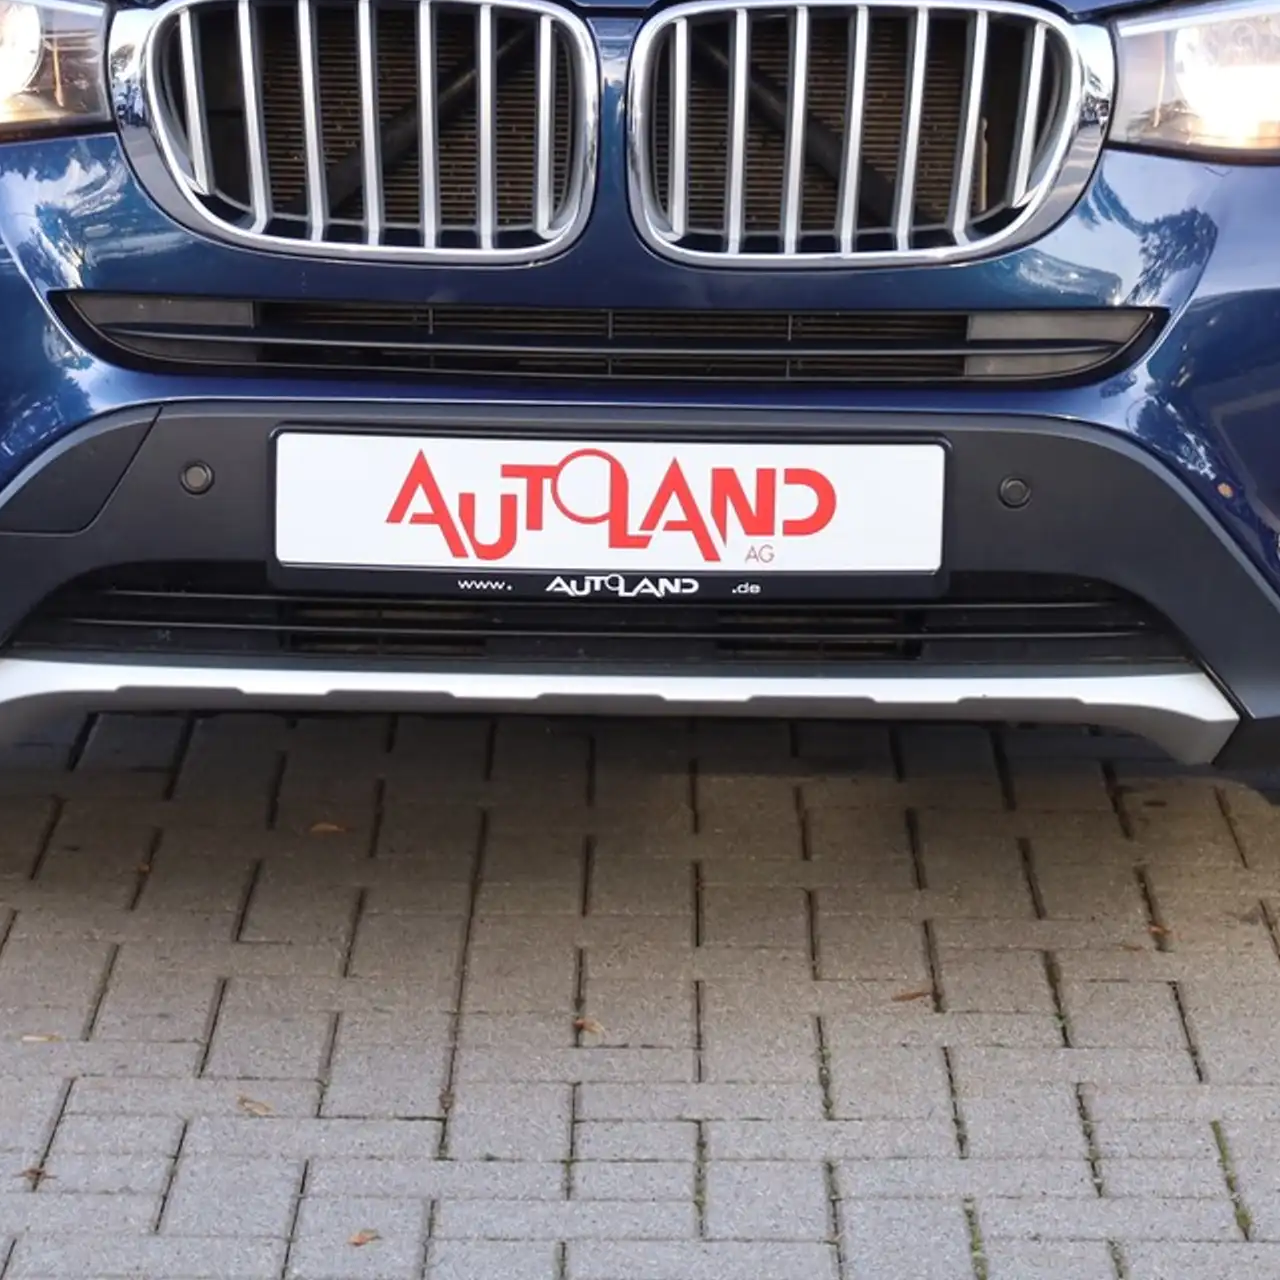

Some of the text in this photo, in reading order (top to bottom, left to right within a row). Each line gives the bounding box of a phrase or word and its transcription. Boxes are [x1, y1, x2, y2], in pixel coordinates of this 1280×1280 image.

[385, 448, 838, 562] AUTOLAND
[744, 544, 775, 564] AG
[457, 573, 761, 599] www. AUTOLAND .de
